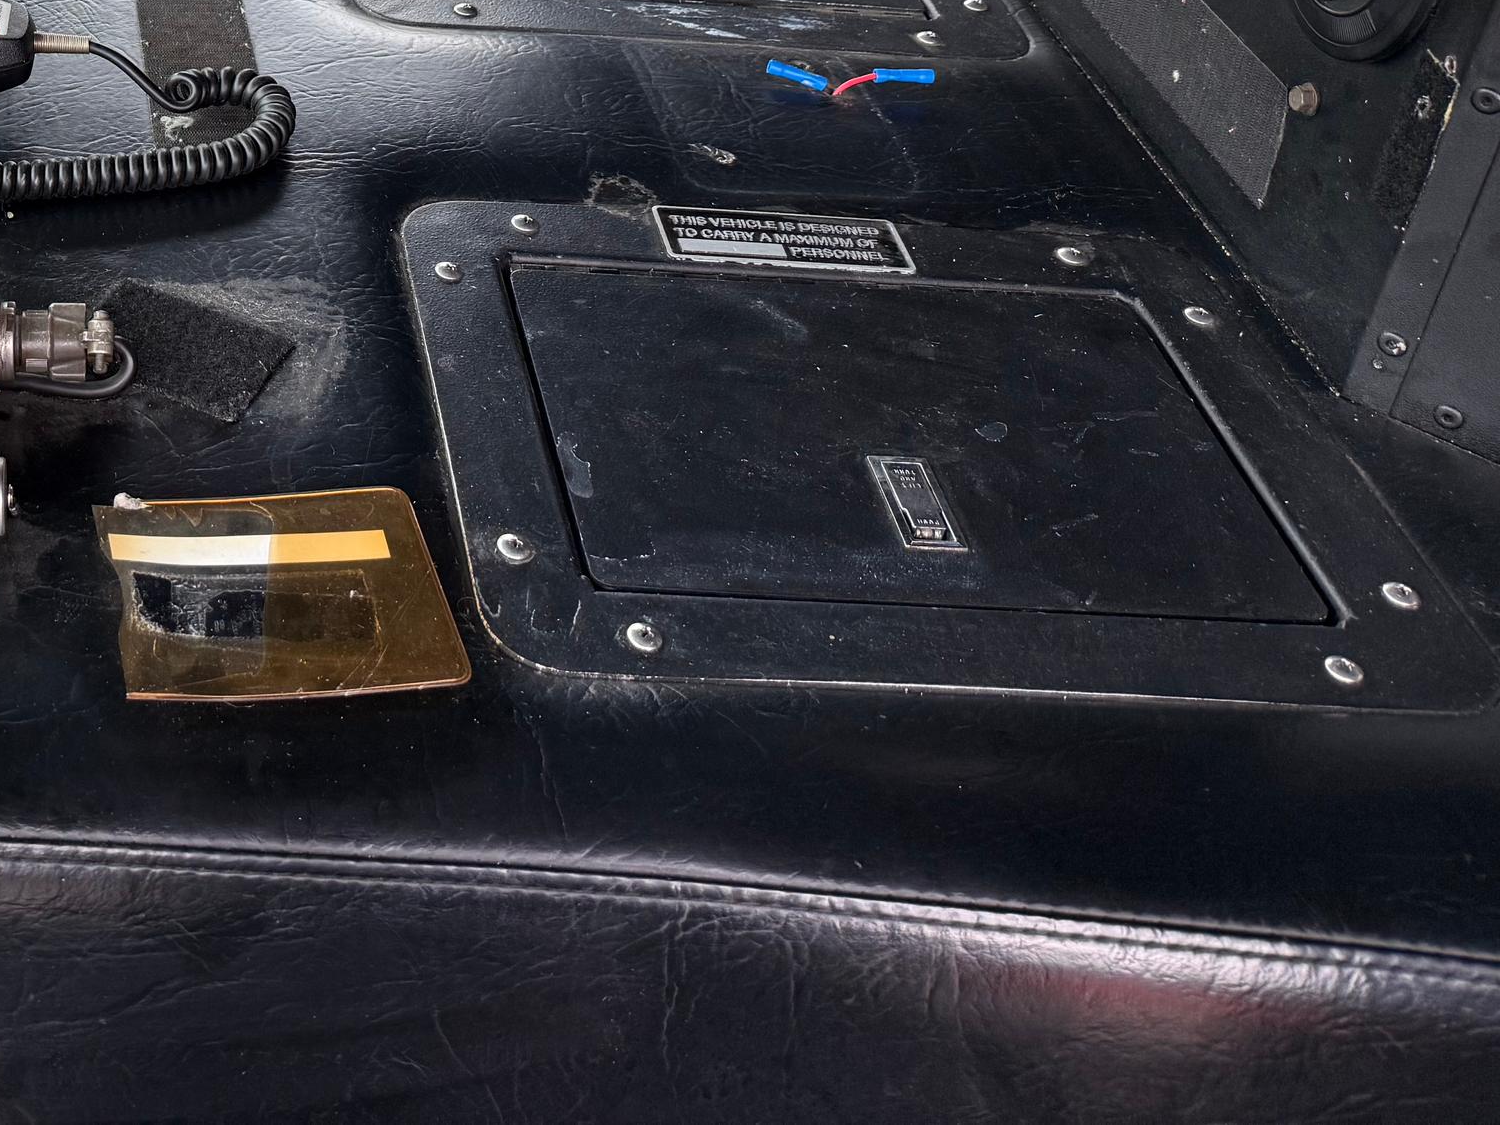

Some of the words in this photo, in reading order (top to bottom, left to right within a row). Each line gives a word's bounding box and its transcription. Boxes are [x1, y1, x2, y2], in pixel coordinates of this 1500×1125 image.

[668, 214, 708, 227] THIS
[707, 216, 778, 231] VEHICLE
[778, 221, 796, 232] IS
[796, 222, 880, 236] DESIGNED
[672, 226, 698, 238] TO
[700, 228, 755, 242] CARRY
[759, 232, 773, 243] A
[772, 233, 855, 248] MAXIMUM
[856, 238, 879, 249] OF
[788, 246, 891, 262] PERSONNEL
